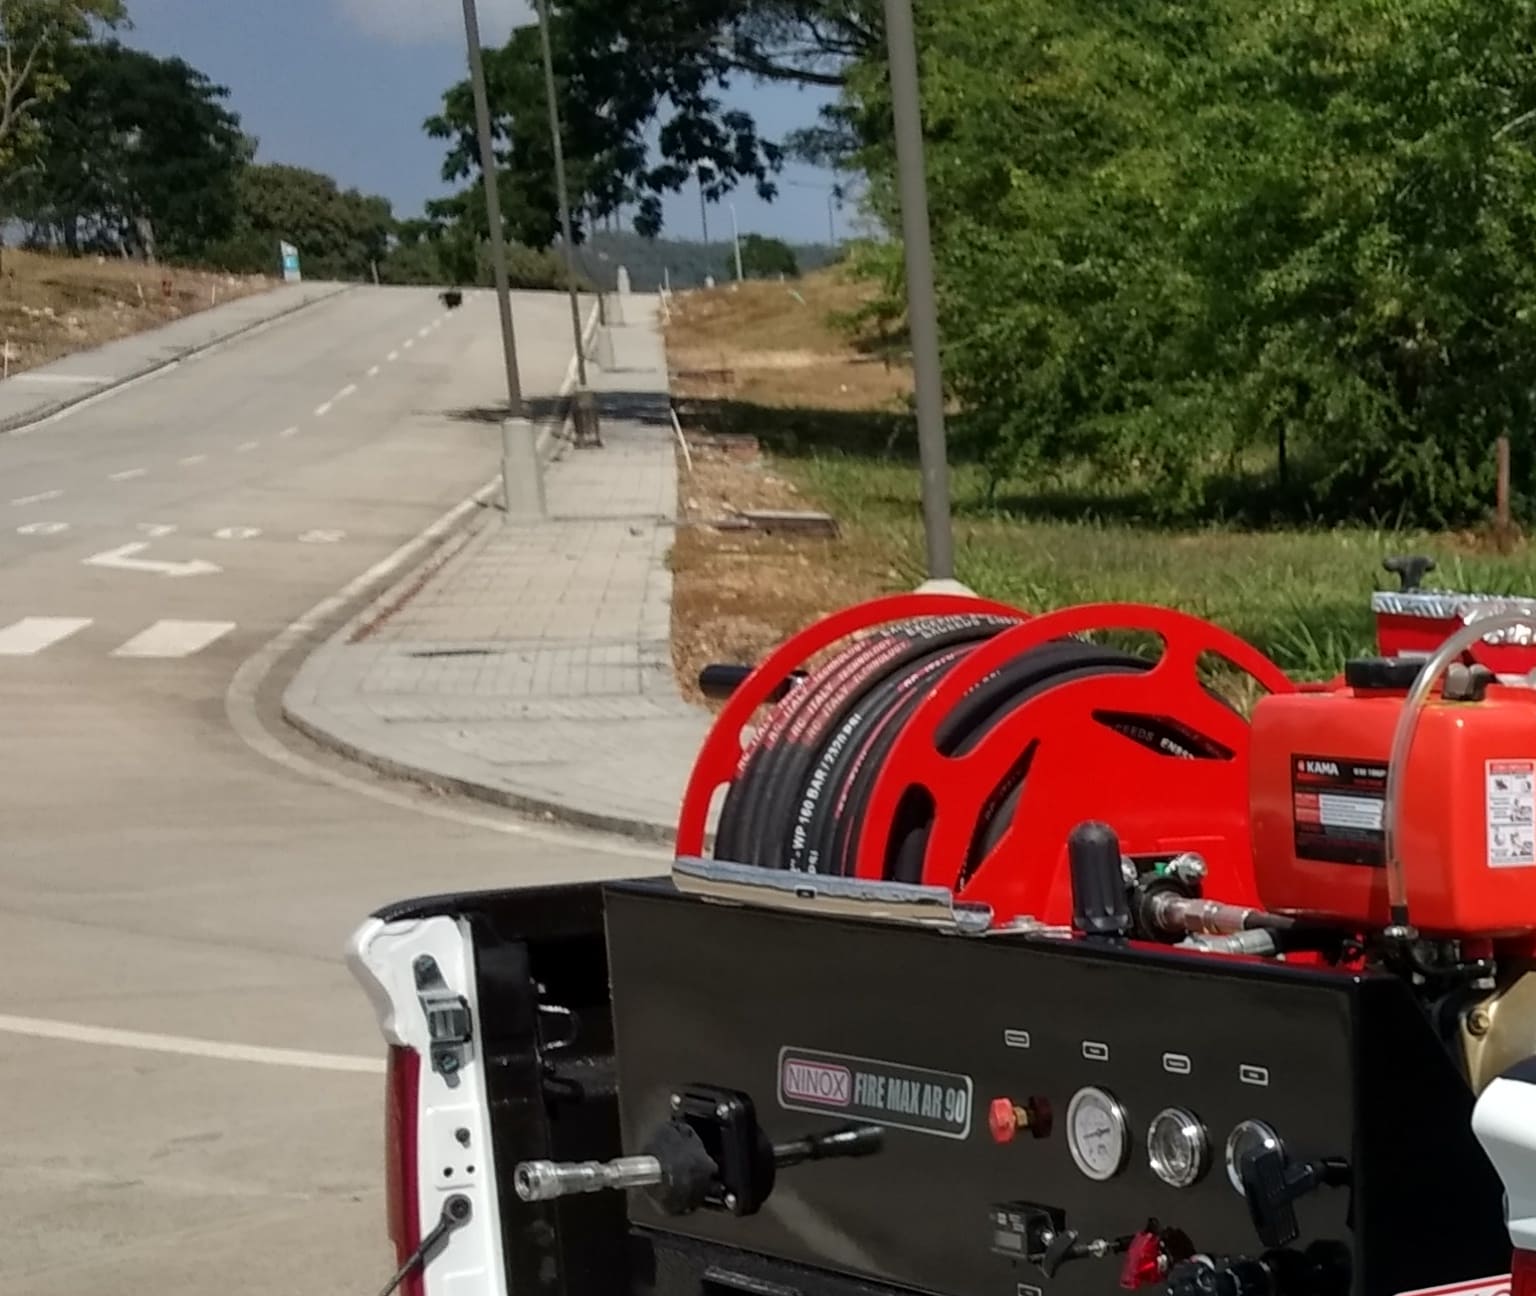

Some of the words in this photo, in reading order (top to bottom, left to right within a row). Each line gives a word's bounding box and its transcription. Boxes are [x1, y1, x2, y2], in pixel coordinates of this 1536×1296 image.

[807, 681, 833, 714] ITALY
[822, 684, 850, 717] ITALY
[1306, 761, 1339, 776] KAMA
[792, 824, 807, 850] WP
[806, 768, 828, 800] BAR
[788, 1066, 847, 1099] NINOX
[854, 1072, 885, 1109] FIRE
[887, 1077, 920, 1115] MAX
[921, 1084, 943, 1118] AR
[944, 1088, 967, 1124] 90
